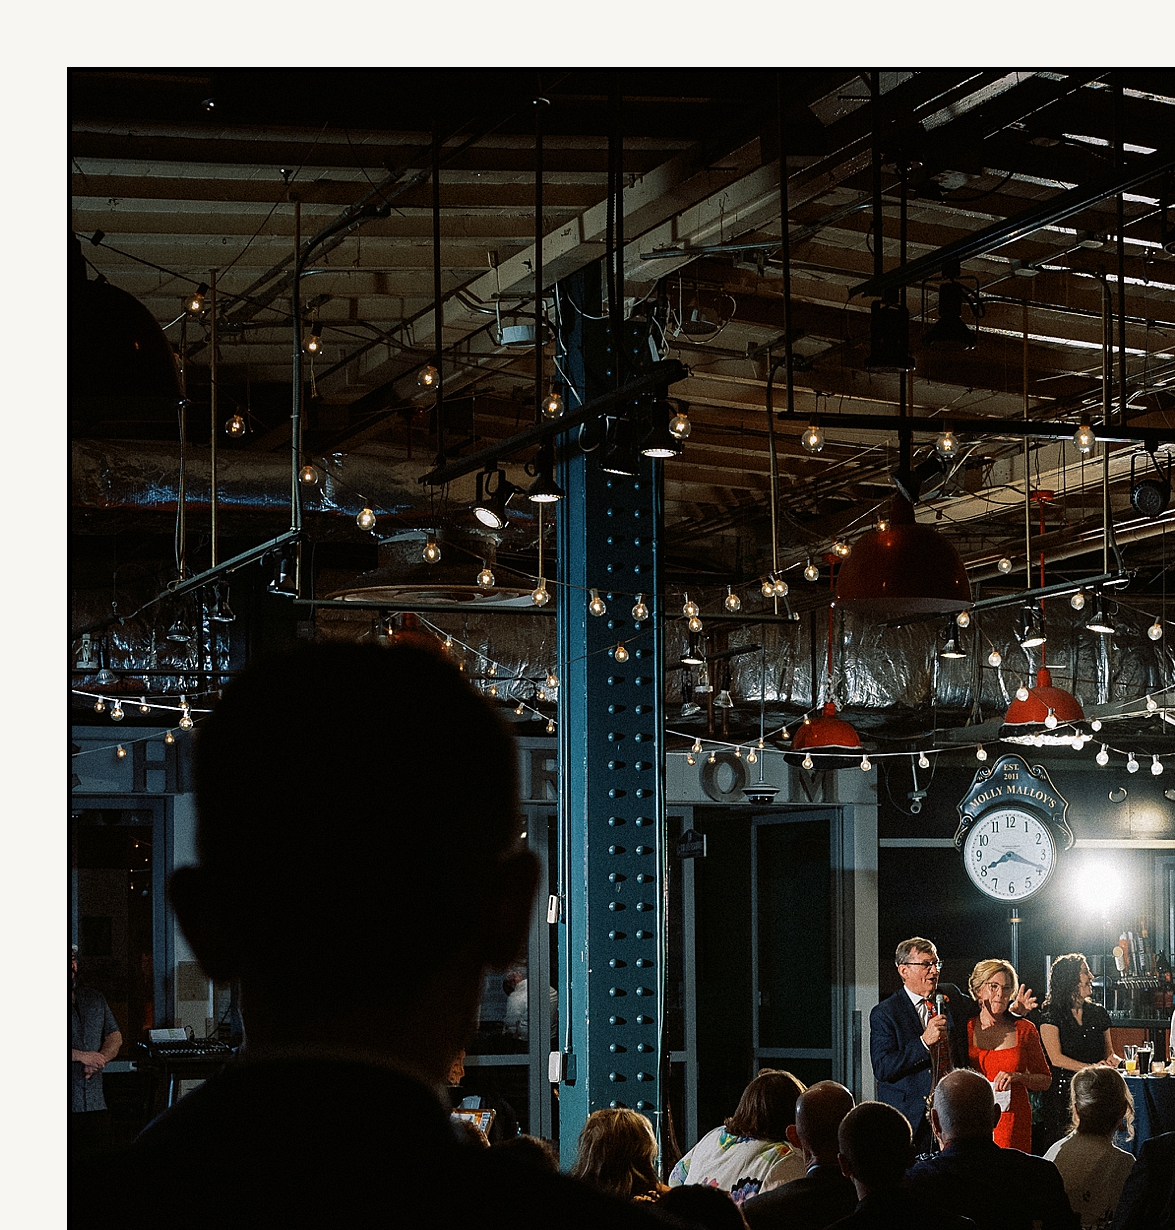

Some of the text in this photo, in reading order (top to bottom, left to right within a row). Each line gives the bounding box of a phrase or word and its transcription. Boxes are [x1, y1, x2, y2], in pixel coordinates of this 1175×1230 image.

[530, 750, 837, 803] ROM
[969, 785, 1057, 810] MOLLY MALLOY'S
[991, 821, 999, 833] 11
[1006, 816, 1016, 828] 12
[1024, 821, 1029, 833] 1
[979, 834, 989, 846] 10
[1035, 833, 1042, 845] 2
[976, 850, 983, 862] 9
[1040, 849, 1046, 860] 3
[980, 865, 988, 877] 8
[991, 877, 998, 889] 7
[1008, 882, 1015, 893] 6
[1024, 877, 1032, 889] 5
